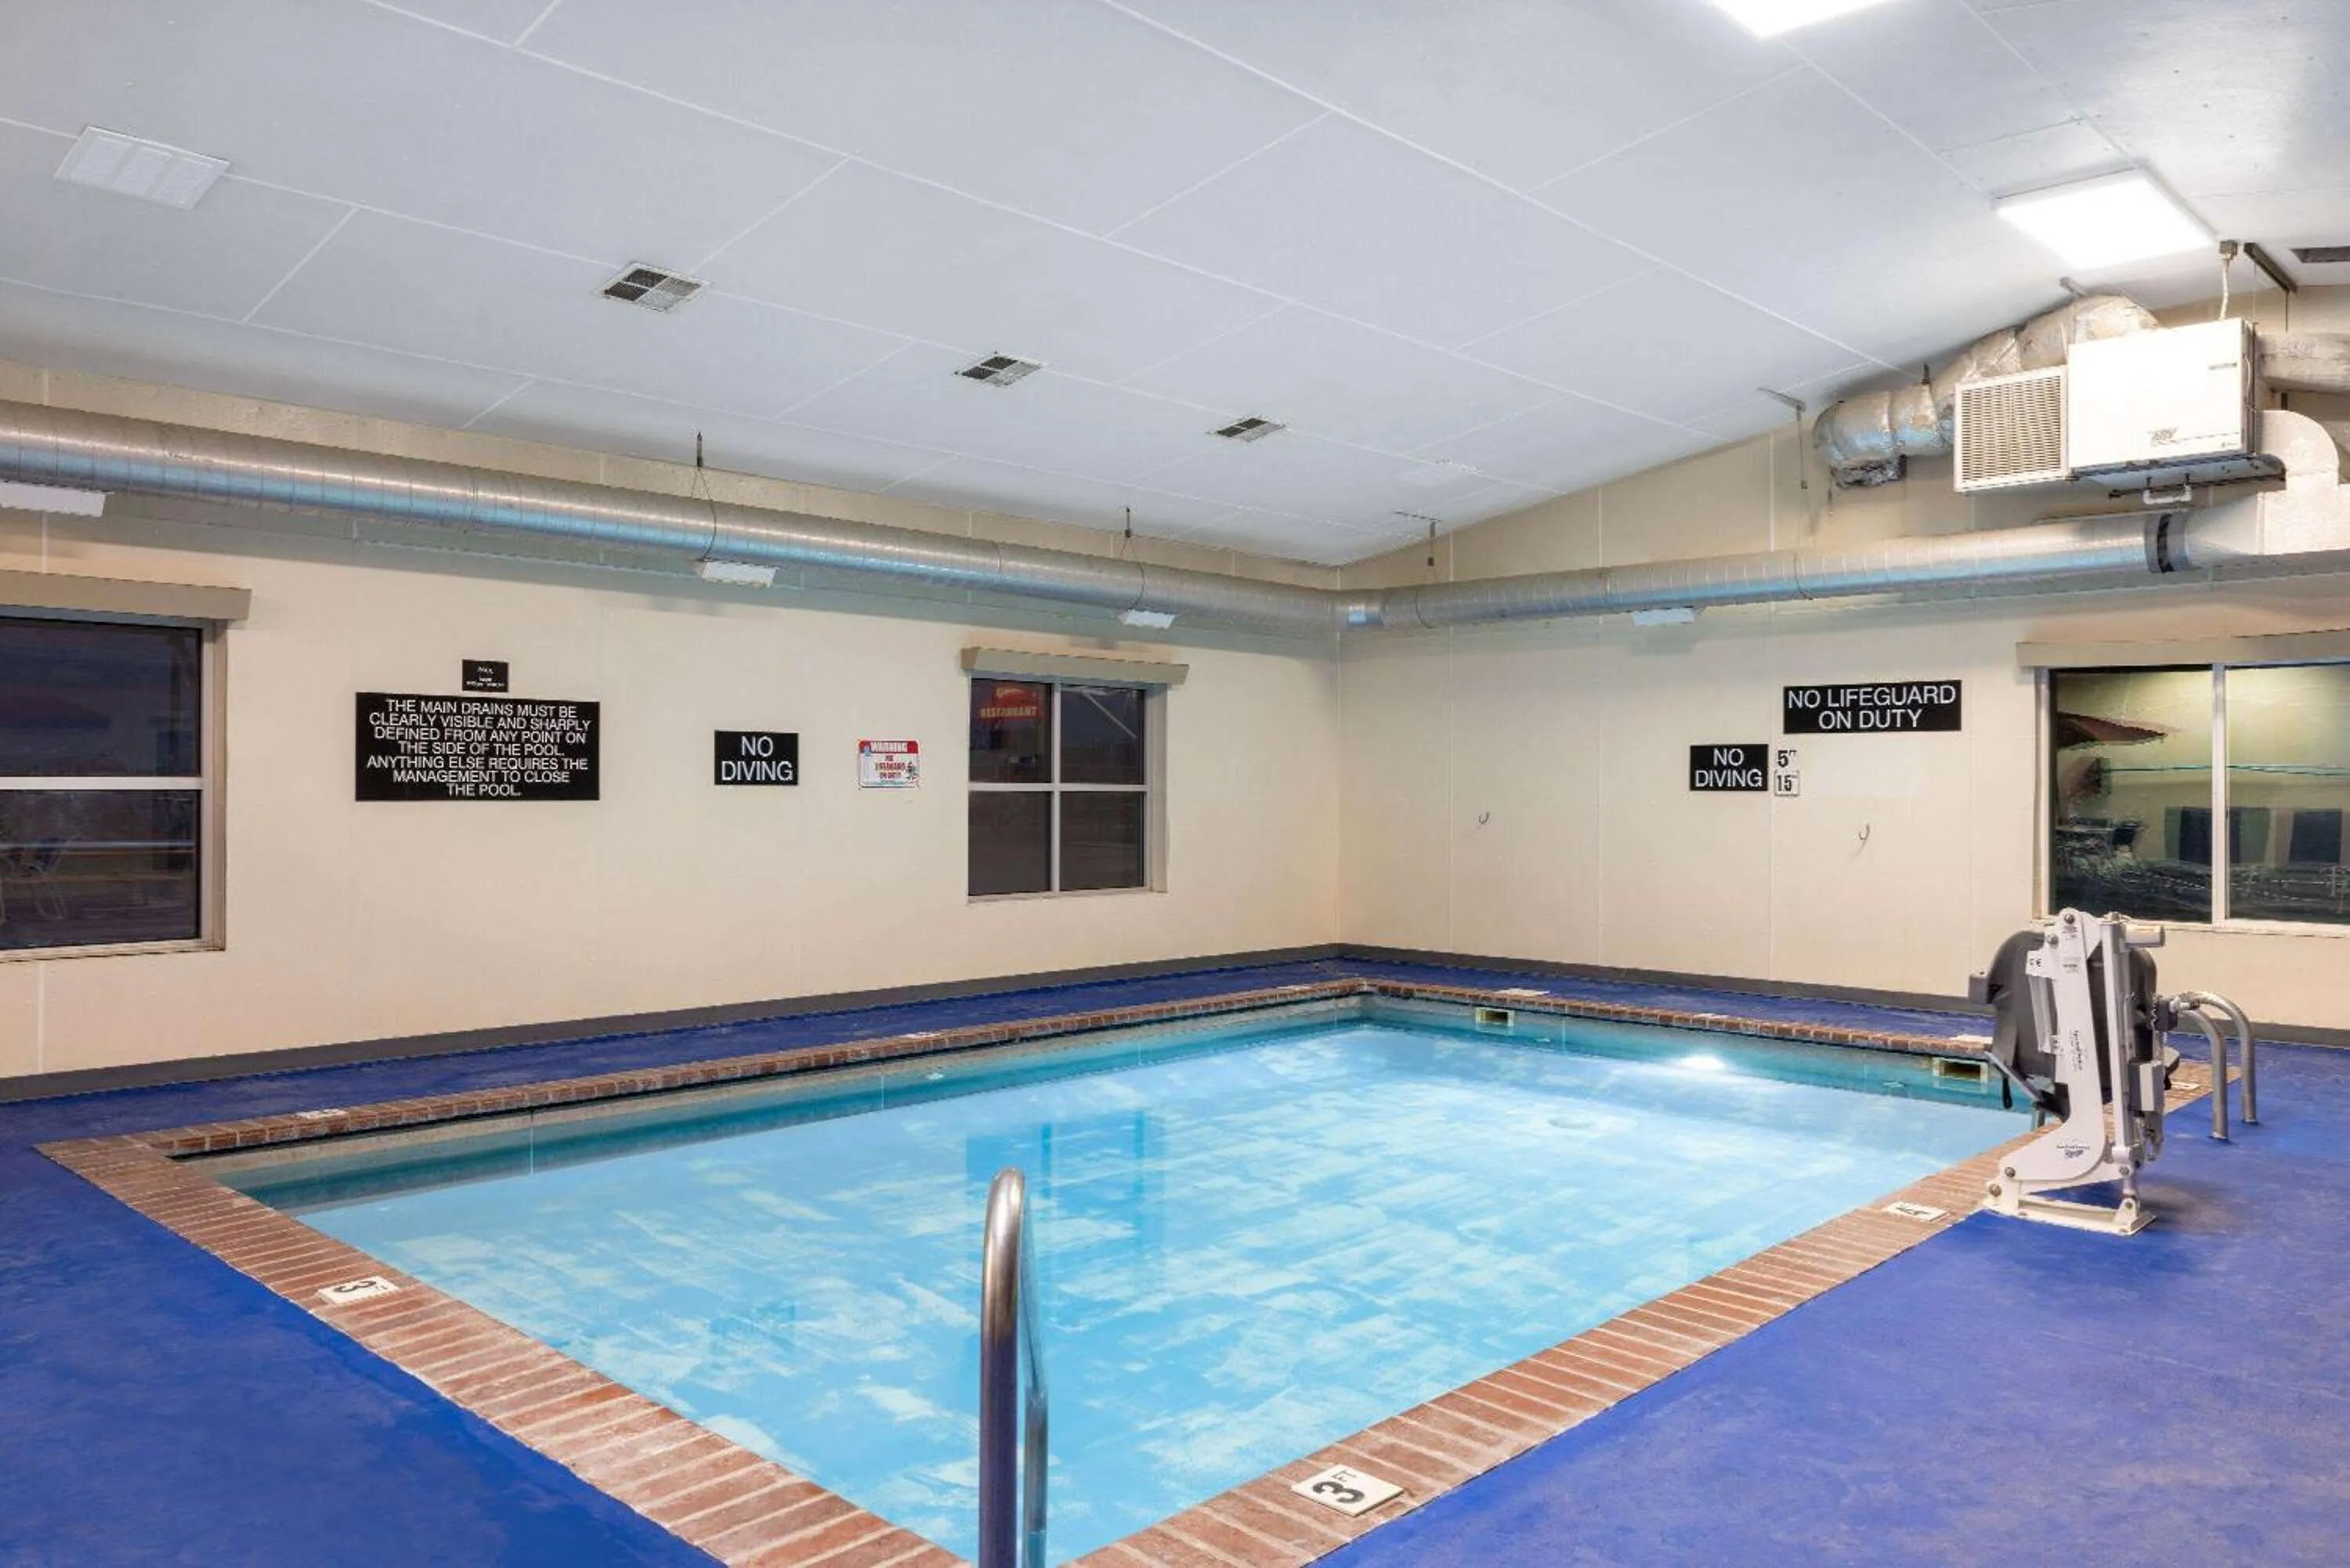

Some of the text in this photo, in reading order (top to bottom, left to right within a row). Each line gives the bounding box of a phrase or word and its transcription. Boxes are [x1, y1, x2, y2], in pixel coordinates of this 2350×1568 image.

[1788, 686, 1955, 708] NO LIFEGUARD
[386, 699, 577, 718] THE MAIN DRAINS MUST BE
[369, 713, 591, 731] CLEARLY VISIBLE AND SHARPLY
[1819, 709, 1922, 729] ON DUTY
[374, 727, 586, 744] DEFINED FROM ANY POINT ON
[398, 741, 564, 756] THE SIDE OF THE POOL.
[741, 736, 773, 757] NO
[367, 756, 588, 770] ANYTHING ELSE REQUIRES THE
[1714, 749, 1744, 766] NO
[393, 770, 569, 782] MANAGEMENT TO CLOSE
[721, 761, 793, 781] DIVING
[1695, 769, 1762, 787] DIVING
[446, 784, 522, 796] THE POOL.
[1312, 1481, 1365, 1504] 3
